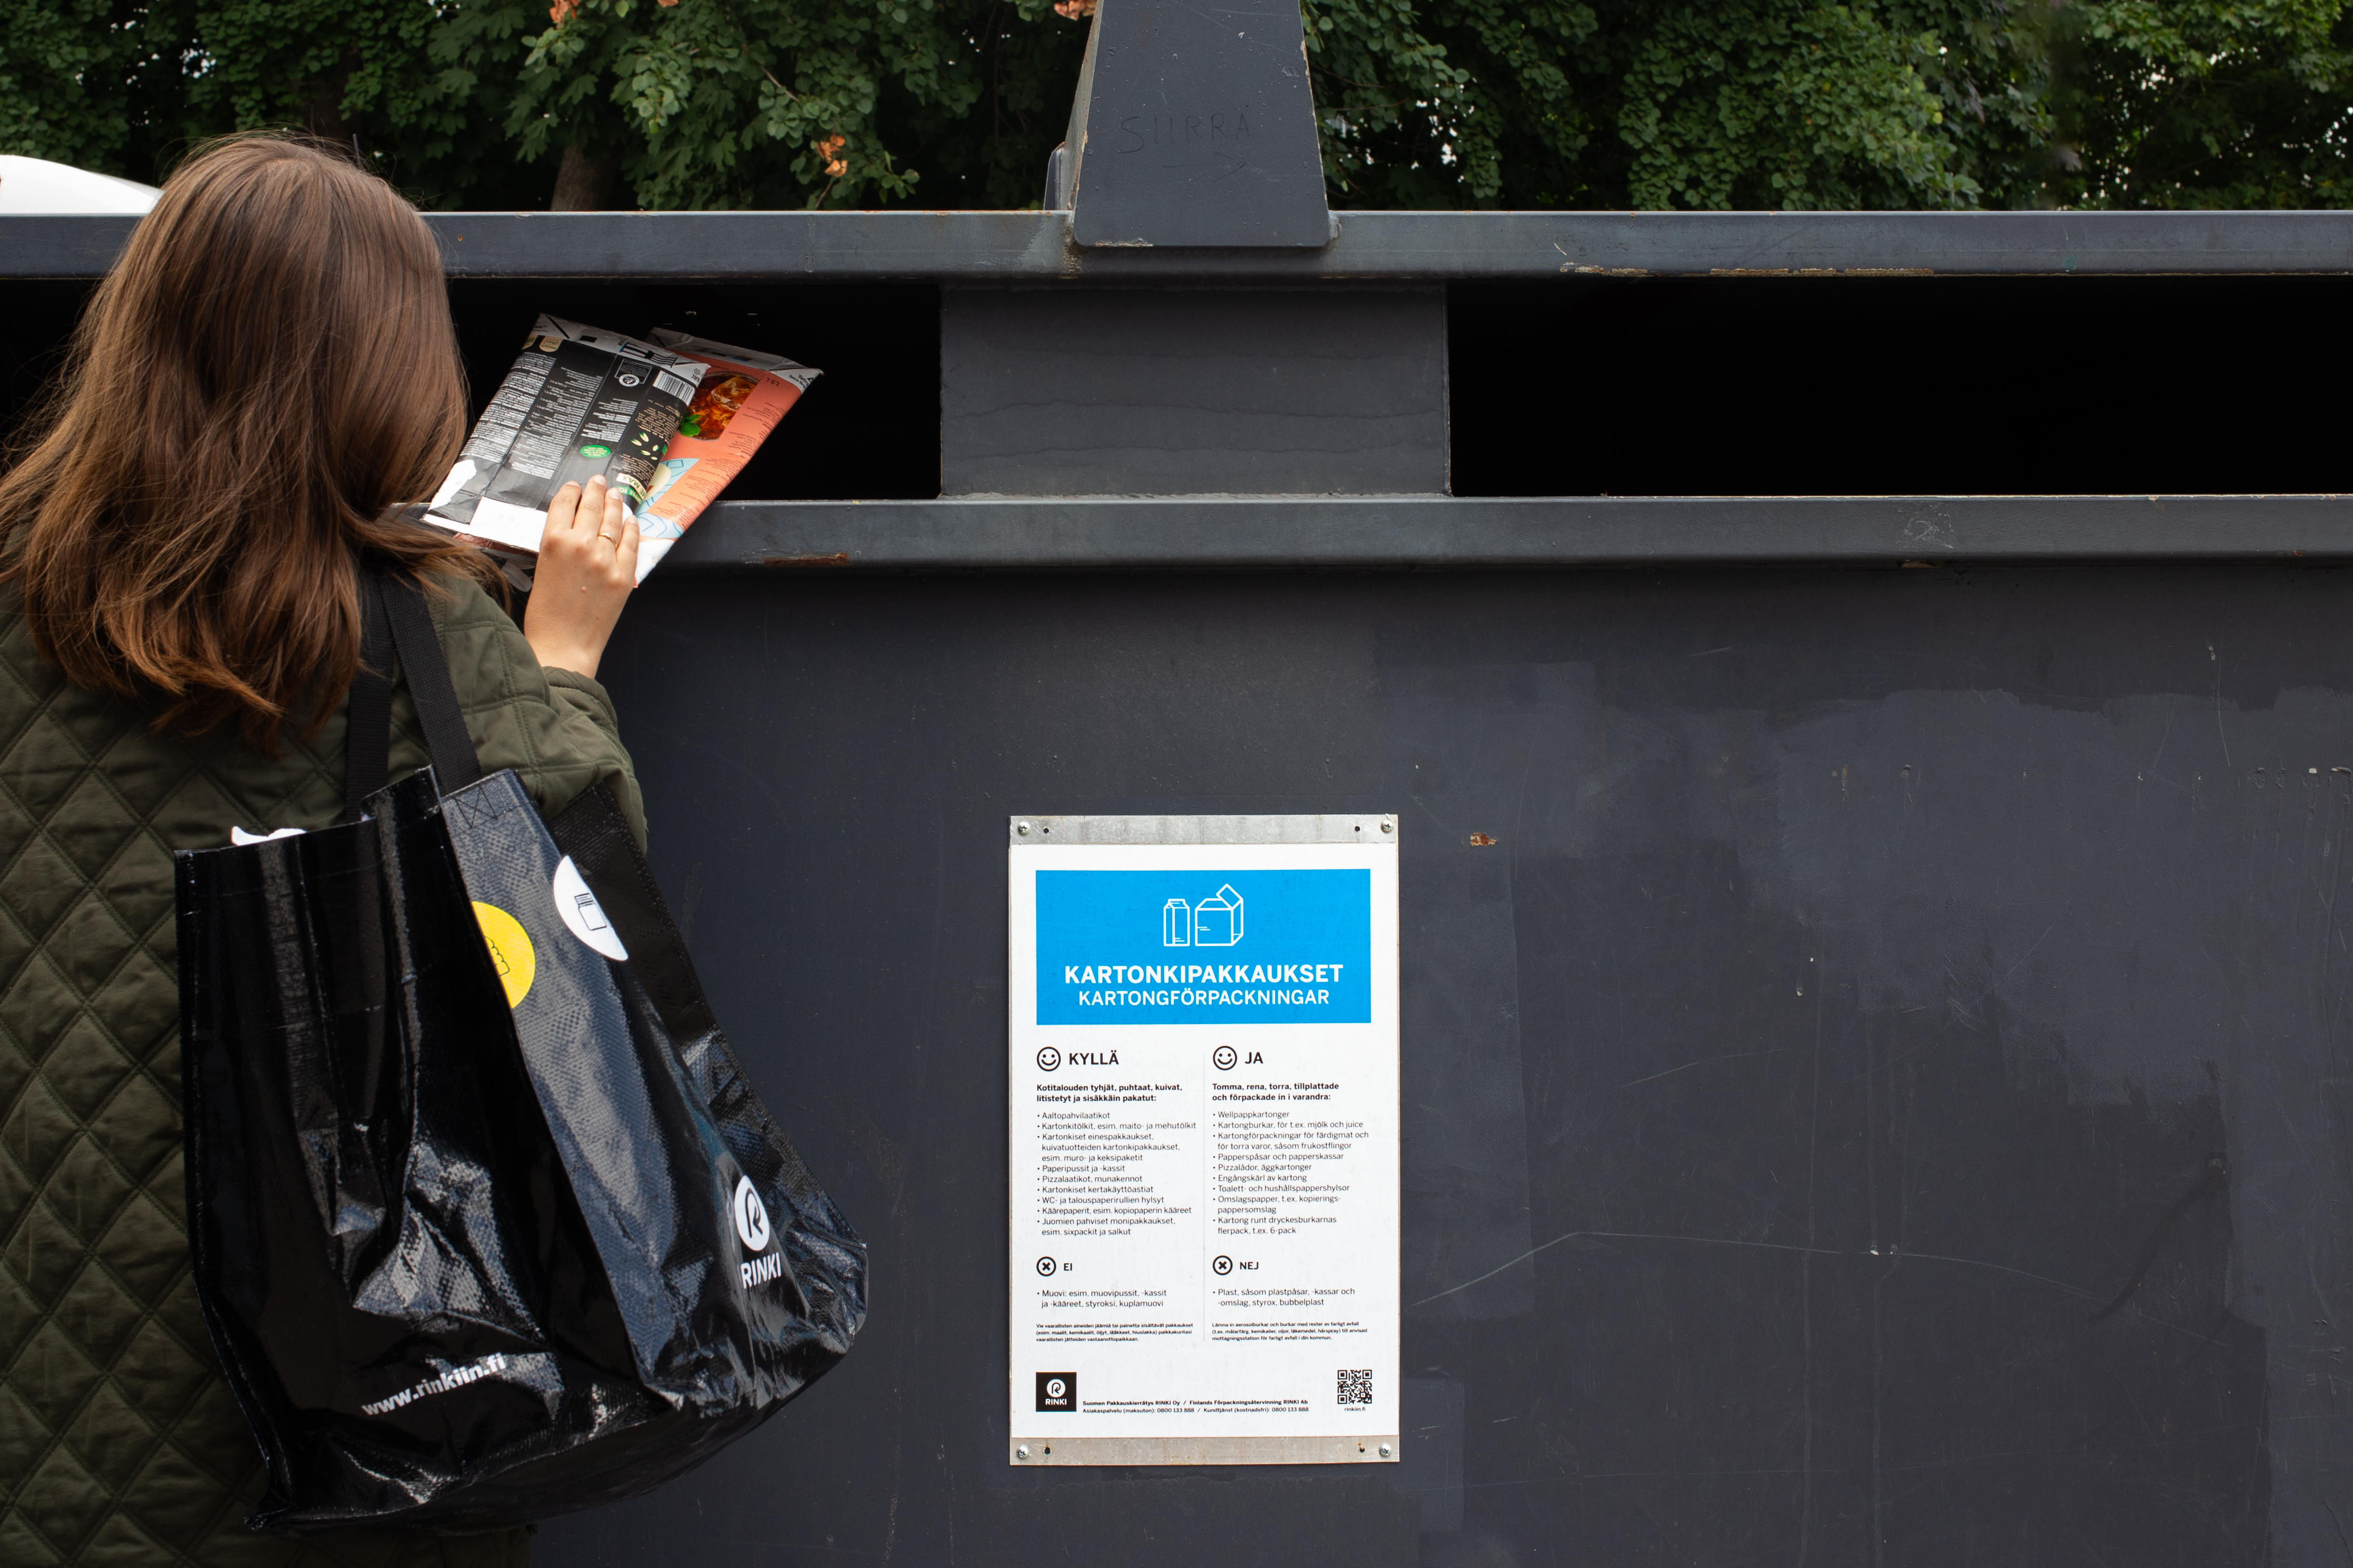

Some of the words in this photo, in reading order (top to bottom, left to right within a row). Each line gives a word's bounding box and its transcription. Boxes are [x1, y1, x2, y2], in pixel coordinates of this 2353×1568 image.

[622, 475, 641, 489] MAX
[1065, 964, 1343, 984] KARTONKIPAKKAUKSET
[1079, 988, 1329, 1005] KARTONGFÖRPACKNINGAR
[1069, 1049, 1119, 1066] KYLLÄ
[1244, 1052, 1264, 1065] JA
[1090, 1084, 1117, 1093] tyhjät,
[1119, 1084, 1153, 1093] puhtaat,
[1155, 1083, 1183, 1092] kuivat,
[1212, 1083, 1245, 1091] Tomma,
[1293, 1082, 1339, 1091] tillplattade
[1036, 1095, 1072, 1103] litistetyt
[1073, 1094, 1081, 1103] ja
[1123, 1094, 1157, 1103] pakatut:
[1229, 1093, 1276, 1102] förpackade
[1042, 1112, 1110, 1121] Aaltopahvilaatikot
[1218, 1111, 1290, 1120] Wellpappkartonger
[1218, 1121, 1275, 1130] Kartongburkar,
[1307, 1121, 1328, 1129] mjölk
[1345, 1121, 1363, 1129] juice
[1088, 1133, 1154, 1141] einespakkaukset,
[1218, 1131, 1302, 1141] Kartongförpackningar
[1316, 1131, 1353, 1140] färdigmat
[1103, 1143, 1180, 1152] kartonkipakkaukset,
[1301, 1142, 1352, 1151] frukostflingor
[1097, 1154, 1143, 1163] keksipaketit
[1218, 1153, 1271, 1162] Papperspåsar
[1289, 1152, 1344, 1162] papperskassar
[1042, 1165, 1090, 1174] Paperipussit
[1261, 1164, 1313, 1172] äggkartonger
[1218, 1174, 1265, 1183] Engångskärl
[1277, 1174, 1307, 1183] kartong
[1088, 1185, 1154, 1195] kertakäyttöastiat
[1264, 1184, 1350, 1193] hushållspappershylsor
[1059, 1196, 1066, 1205] ja
[1068, 1196, 1140, 1205] talouspaperirullien
[1141, 1196, 1164, 1205] hylsyt
[1218, 1195, 1280, 1204] Omslagspapper,
[1299, 1195, 1341, 1204] kopierings-
[1042, 1207, 1092, 1216] Käärepaperit,
[1114, 1207, 1162, 1216] kopiopaperin
[1218, 1206, 1277, 1215] pappersomslag
[1076, 1218, 1108, 1226] pahviset
[1110, 1217, 1175, 1226] monipakkaukset,
[1218, 1217, 1249, 1225] Kartong
[1268, 1216, 1337, 1225] dryckesburkarnas
[1063, 1228, 1098, 1237] sixpackit
[1099, 1228, 1106, 1237] ja
[1218, 1227, 1251, 1236] flerpack,
[1270, 1226, 1296, 1235] 6-pack
[740, 1251, 781, 1289] RINKI
[1063, 1262, 1073, 1272] EI
[1239, 1261, 1259, 1270] NEJ
[1091, 1289, 1140, 1298] muovipussit,
[1268, 1288, 1310, 1297] plastpåsar,
[1041, 1300, 1048, 1309] ja
[1085, 1300, 1118, 1309] styroksi,
[1119, 1300, 1164, 1308] kuplamuovi
[1218, 1299, 1251, 1308] -omslag,
[1252, 1299, 1278, 1307] styrox,
[1279, 1298, 1324, 1307] bubbelplast
[361, 1352, 506, 1415] www.rinkiin.fi
